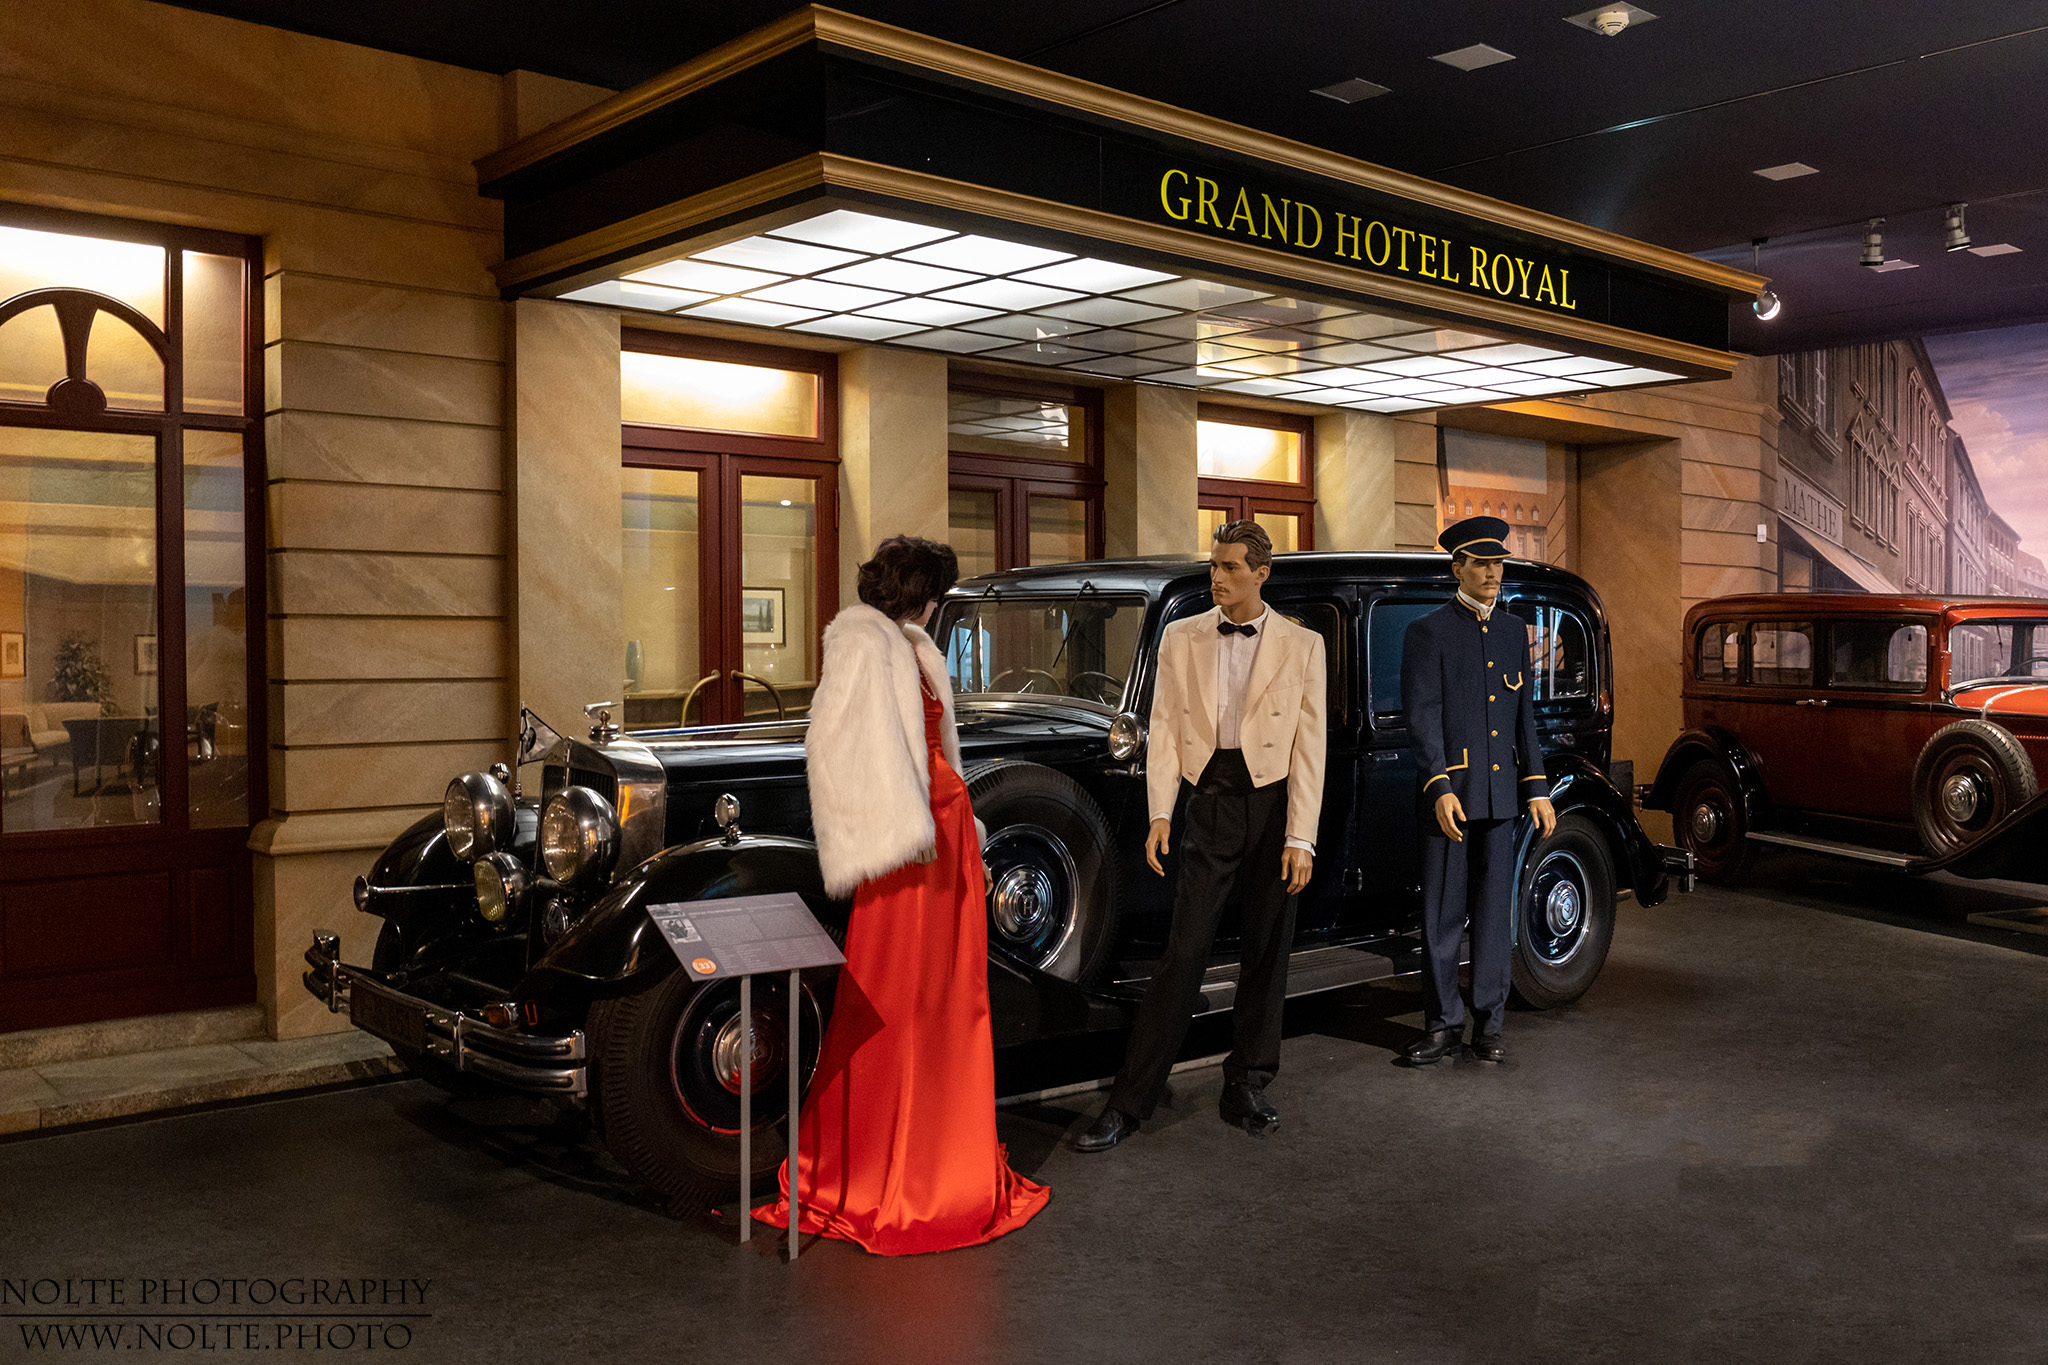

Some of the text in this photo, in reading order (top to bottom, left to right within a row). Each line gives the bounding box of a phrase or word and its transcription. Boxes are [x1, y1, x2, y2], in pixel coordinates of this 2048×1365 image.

[1160, 169, 1577, 310] GRAND HOTEL ROYAL
